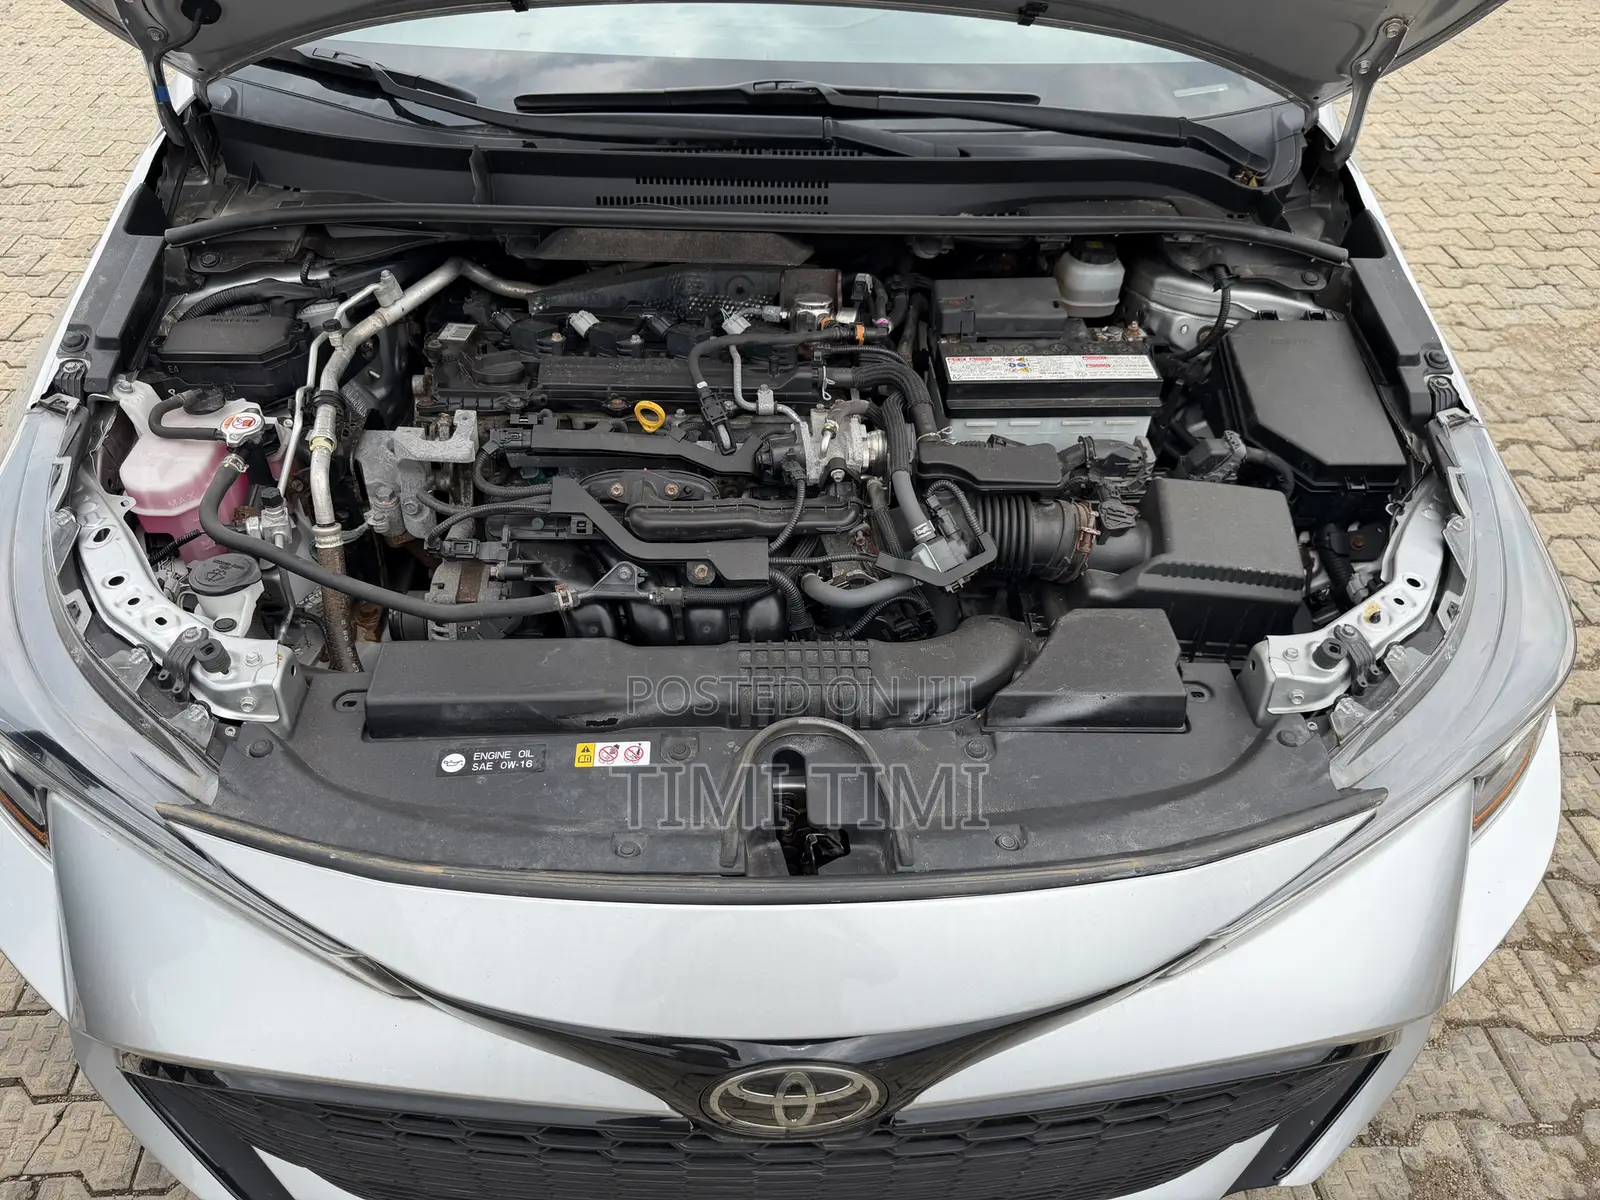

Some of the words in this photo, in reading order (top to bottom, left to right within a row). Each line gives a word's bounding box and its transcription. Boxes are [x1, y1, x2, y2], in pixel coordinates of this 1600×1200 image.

[167, 491, 197, 508] MAX
[473, 751, 512, 761] ENGINE
[518, 749, 534, 759] OIL
[472, 762, 494, 771] SAE
[500, 760, 533, 769] 0W-16
